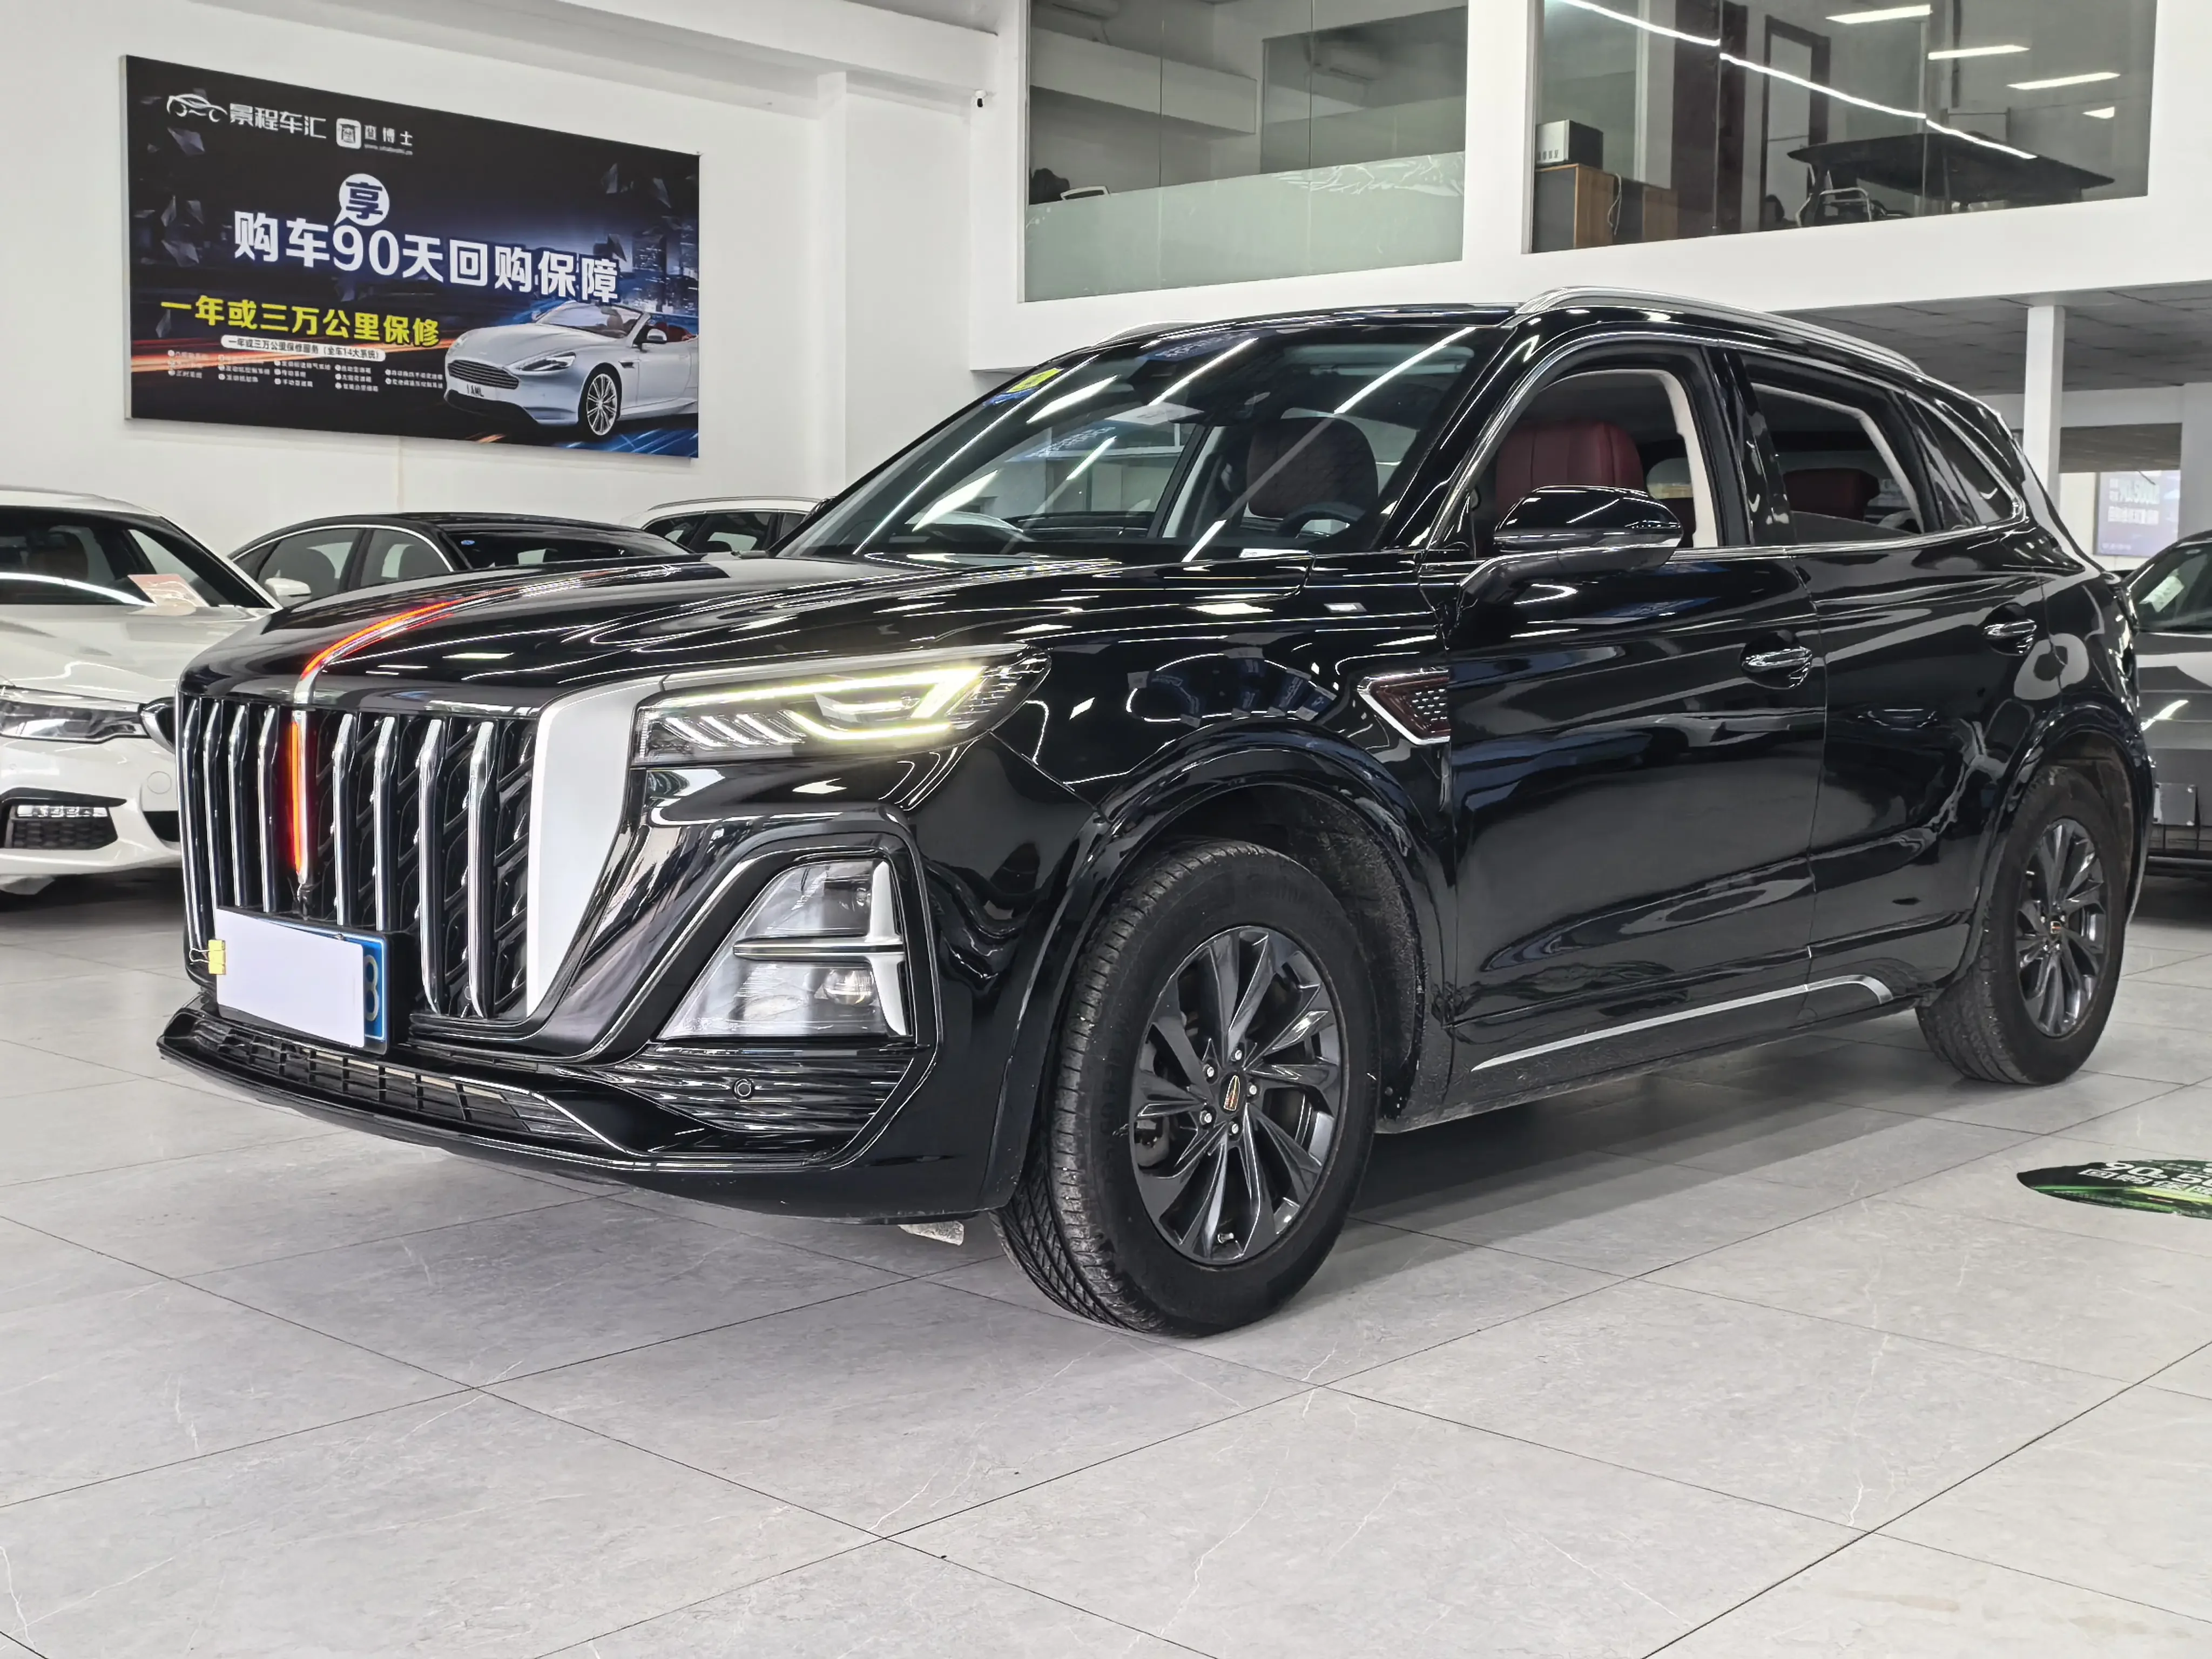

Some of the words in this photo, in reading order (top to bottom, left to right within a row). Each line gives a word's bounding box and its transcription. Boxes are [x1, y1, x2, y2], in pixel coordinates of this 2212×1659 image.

[230, 103, 327, 139] 景程车汇
[345, 181, 383, 222] 享
[234, 211, 618, 303] 购车90天回购保障
[161, 295, 439, 347] 一年或三万公里保修
